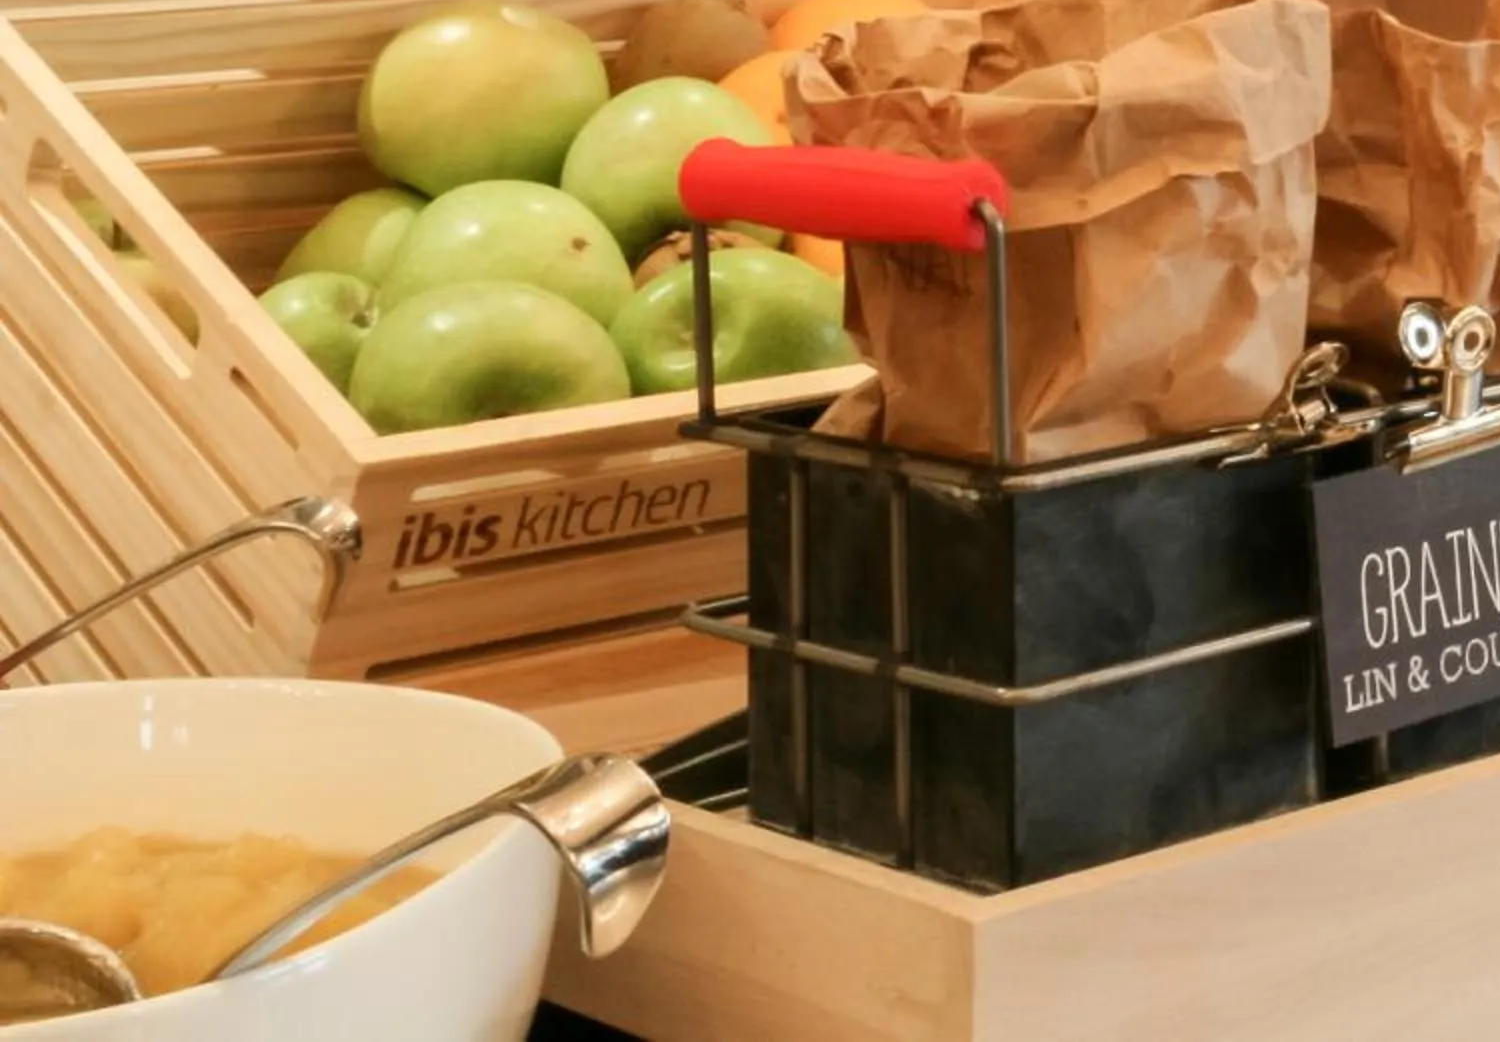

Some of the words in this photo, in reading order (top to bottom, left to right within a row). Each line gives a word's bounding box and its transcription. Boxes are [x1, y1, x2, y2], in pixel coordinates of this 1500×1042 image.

[394, 505, 502, 569] ibis
[512, 479, 711, 548] kitchen
[1343, 661, 1398, 714] LIN
[1407, 654, 1430, 694] &
